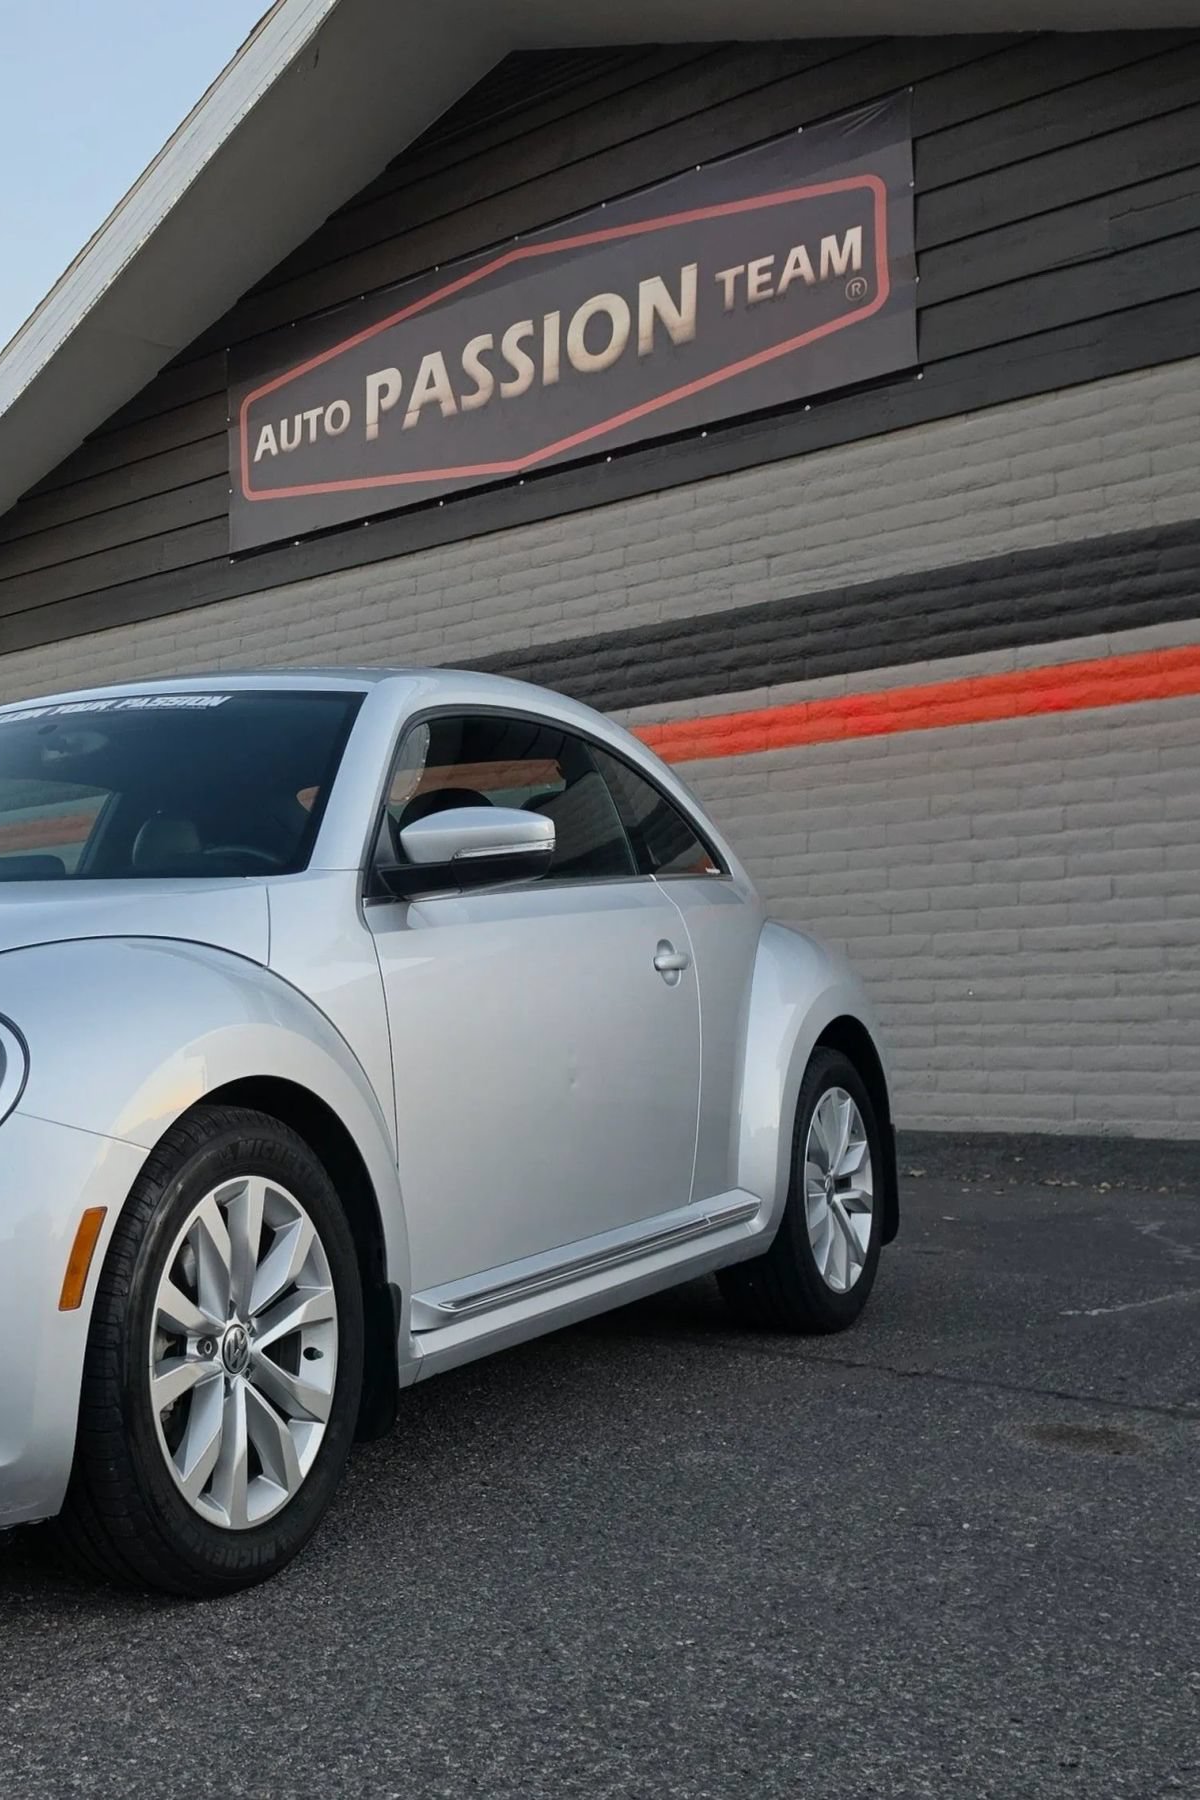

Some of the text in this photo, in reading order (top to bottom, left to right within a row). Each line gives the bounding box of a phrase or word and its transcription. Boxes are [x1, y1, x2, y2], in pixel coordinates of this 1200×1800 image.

[254, 225, 863, 462] AUTO PASSION TEAM
[113, 695, 234, 709] PASSION
